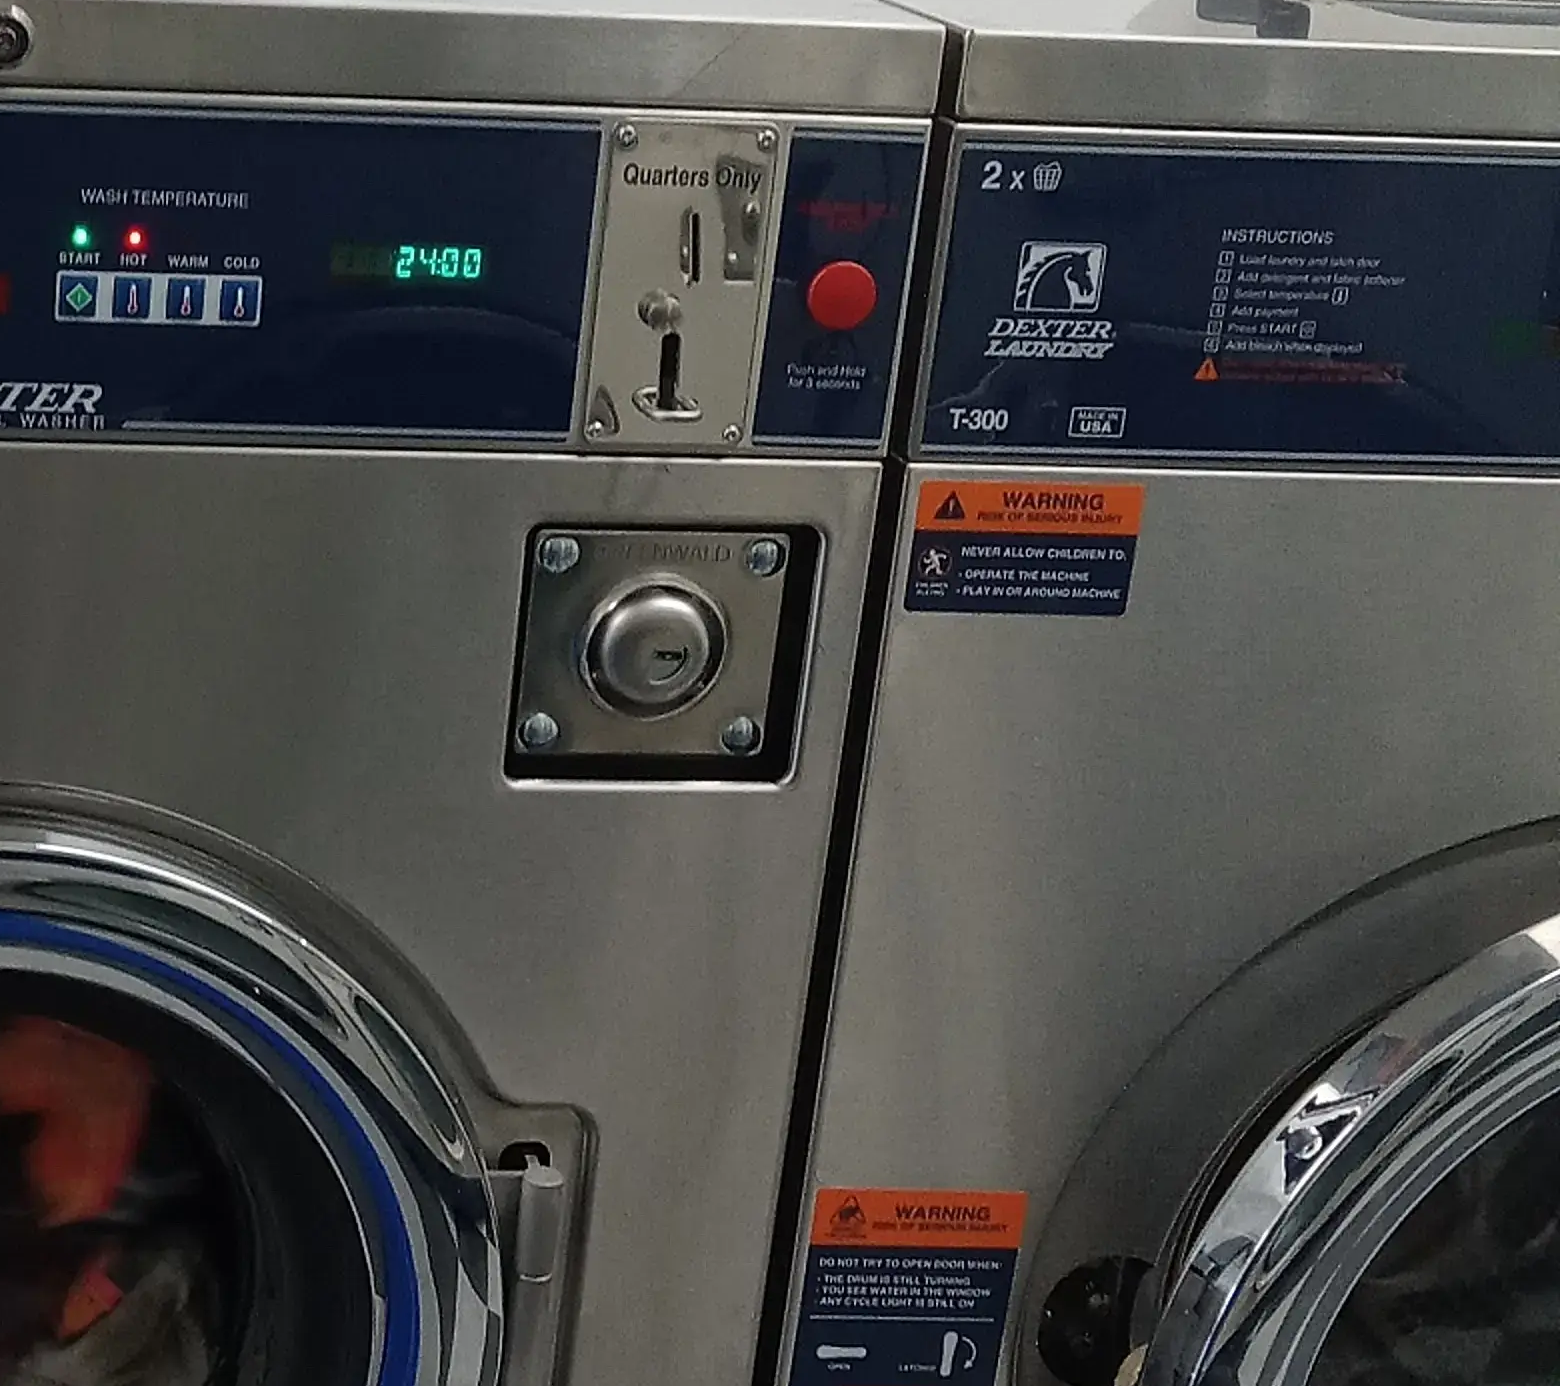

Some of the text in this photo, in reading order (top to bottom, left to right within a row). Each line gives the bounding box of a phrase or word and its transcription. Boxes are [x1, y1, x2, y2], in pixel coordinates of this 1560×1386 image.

[623, 162, 762, 195] Quarters Only
[981, 161, 1024, 191] 2 x
[81, 188, 249, 210] WASH TEMPERATURE
[1221, 228, 1337, 245] INSTRUCTIONS
[59, 251, 261, 270] START HOT WARM COLD
[988, 318, 1116, 340] DEXTER
[983, 339, 1115, 360] LAUNDRY
[787, 363, 815, 376] Push
[817, 364, 838, 377] and
[787, 376, 803, 388] for
[19, 412, 105, 432] WASHER
[949, 408, 1010, 431] T-300
[1079, 420, 1113, 434] USA
[1003, 491, 1106, 512] WARNING
[961, 545, 1002, 558] NEVER
[1003, 546, 1045, 559] ALLOW
[1047, 547, 1107, 561] CHILDREN
[965, 568, 1090, 583] OPERATE THE MACHINE
[961, 584, 991, 597] PLAY
[1005, 585, 1023, 597] OR
[1024, 585, 1070, 599] AROUND
[1071, 587, 1122, 600] MACHINE
[895, 1205, 991, 1222] WARNING
[819, 1256, 835, 1268] DO
[837, 1256, 860, 1268] NOT
[862, 1257, 883, 1269] TRY
[885, 1258, 900, 1269] TO
[902, 1258, 933, 1270] OPEN
[934, 1259, 965, 1270] DOOR
[824, 1274, 844, 1284] THE
[847, 1275, 878, 1285] DRUM
[893, 1275, 920, 1286] STILL
[924, 1276, 971, 1286] TURNING
[822, 1285, 845, 1295] YOU
[869, 1286, 908, 1297] WATER
[923, 1287, 943, 1298] THE
[844, 1298, 878, 1308] CYCLE
[881, 1298, 913, 1309] LIGHT
